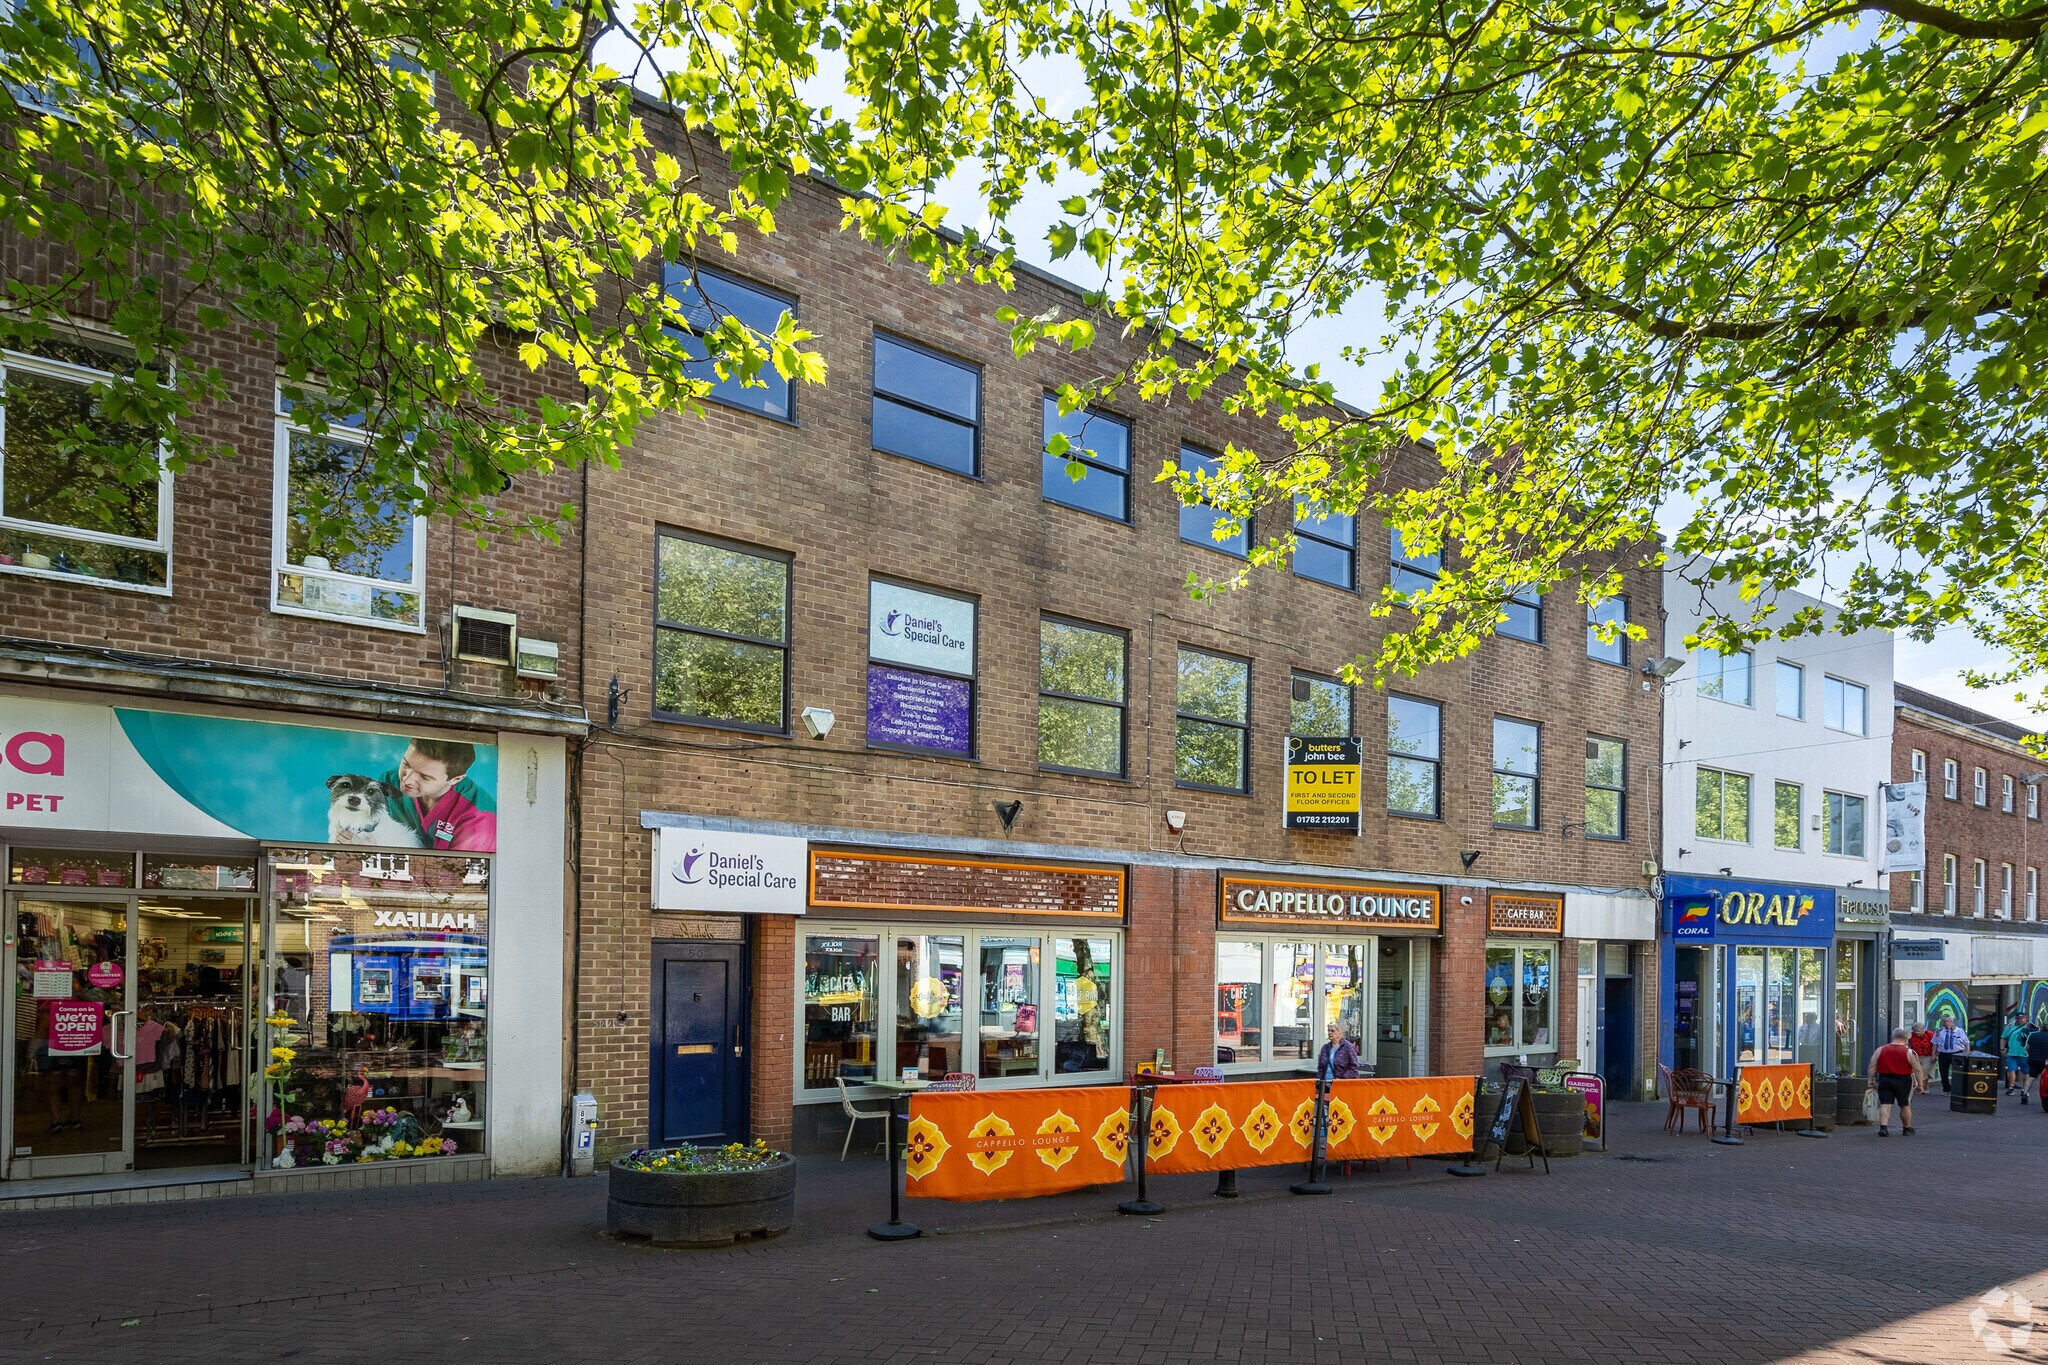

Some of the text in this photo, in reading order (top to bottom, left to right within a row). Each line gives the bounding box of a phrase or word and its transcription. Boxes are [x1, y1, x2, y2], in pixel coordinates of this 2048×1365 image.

[904, 613, 942, 632] Daniel's
[904, 626, 965, 650] Special Care
[920, 680, 936, 688] Home
[0, 731, 65, 777] a
[1308, 744, 1341, 752] butters
[1304, 752, 1346, 762] john bee
[1293, 771, 1355, 784] TO LET
[6, 792, 65, 813] PET
[709, 852, 764, 870] Daniel's
[708, 869, 796, 889] Special Care
[1237, 889, 1431, 918] CAPPELLO LOUNGE
[1712, 889, 1799, 926] ORAL
[1507, 907, 1544, 920] CAFÉ BAR
[1230, 983, 1248, 999] CAFÉ
[55, 1013, 97, 1022] We're
[831, 1007, 851, 1021] BAR
[55, 1022, 96, 1031] OPEN
[1372, 1116, 1406, 1124] CAPPELLO
[580, 1132, 590, 1148] F
[976, 1136, 1070, 1148] CAPPELLO LOUNGE
